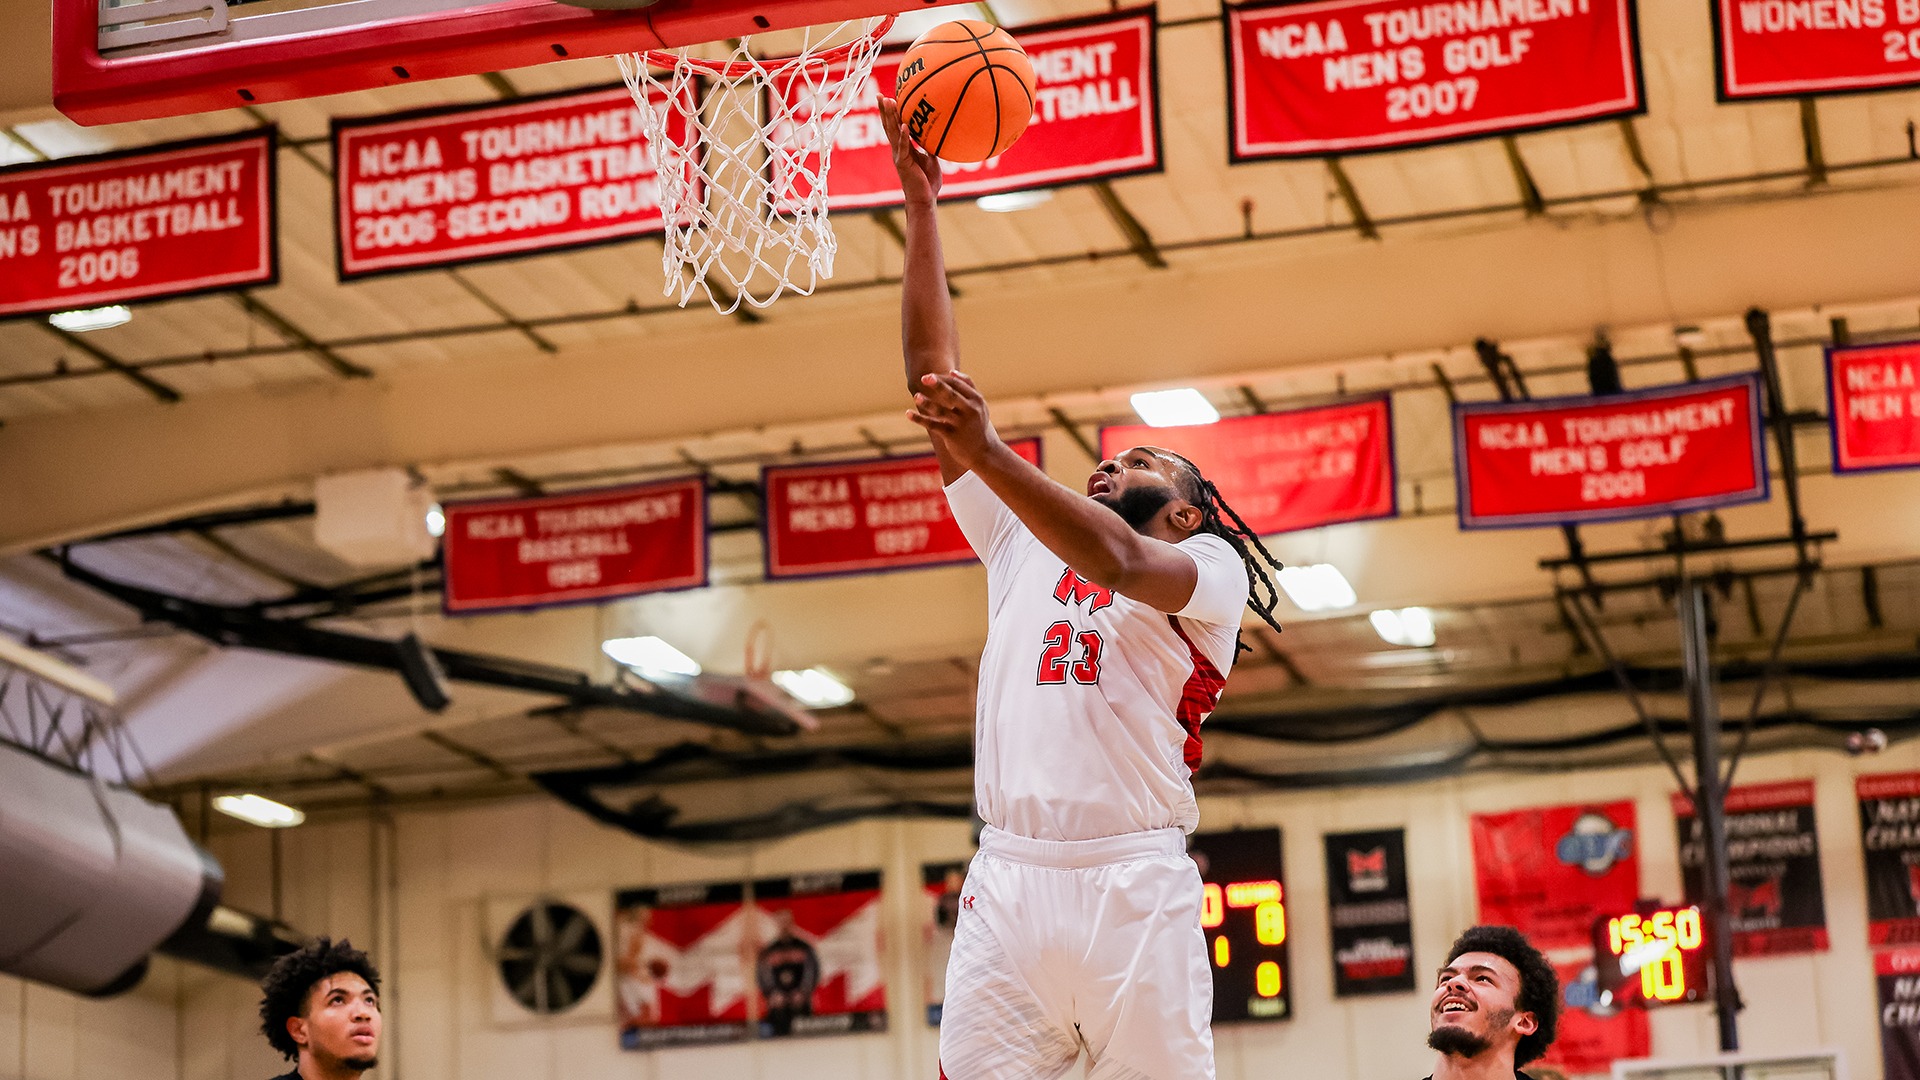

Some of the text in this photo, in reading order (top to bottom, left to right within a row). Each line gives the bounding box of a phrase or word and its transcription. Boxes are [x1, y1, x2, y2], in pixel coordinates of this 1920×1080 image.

[1256, 0, 1591, 60] NCAA TOURNAMENT
[1739, 0, 1887, 34] WOMENS
[1443, 28, 1534, 74] GOLF
[1385, 76, 1479, 122] 2007
[353, 140, 682, 215] WOMENS BASKETBA
[358, 136, 443, 177] NCAA
[48, 159, 245, 217] TOURNAMENT
[579, 174, 682, 221] ROUN
[56, 197, 244, 253] BASKETBALL
[58, 248, 141, 289] 2006
[1846, 362, 1915, 392] NCAA
[1478, 398, 1735, 450] NCAA TOURNAMENT
[1036, 620, 1104, 686] 23
[1608, 908, 1703, 956] 15:50
[1640, 947, 1686, 1001] 10
